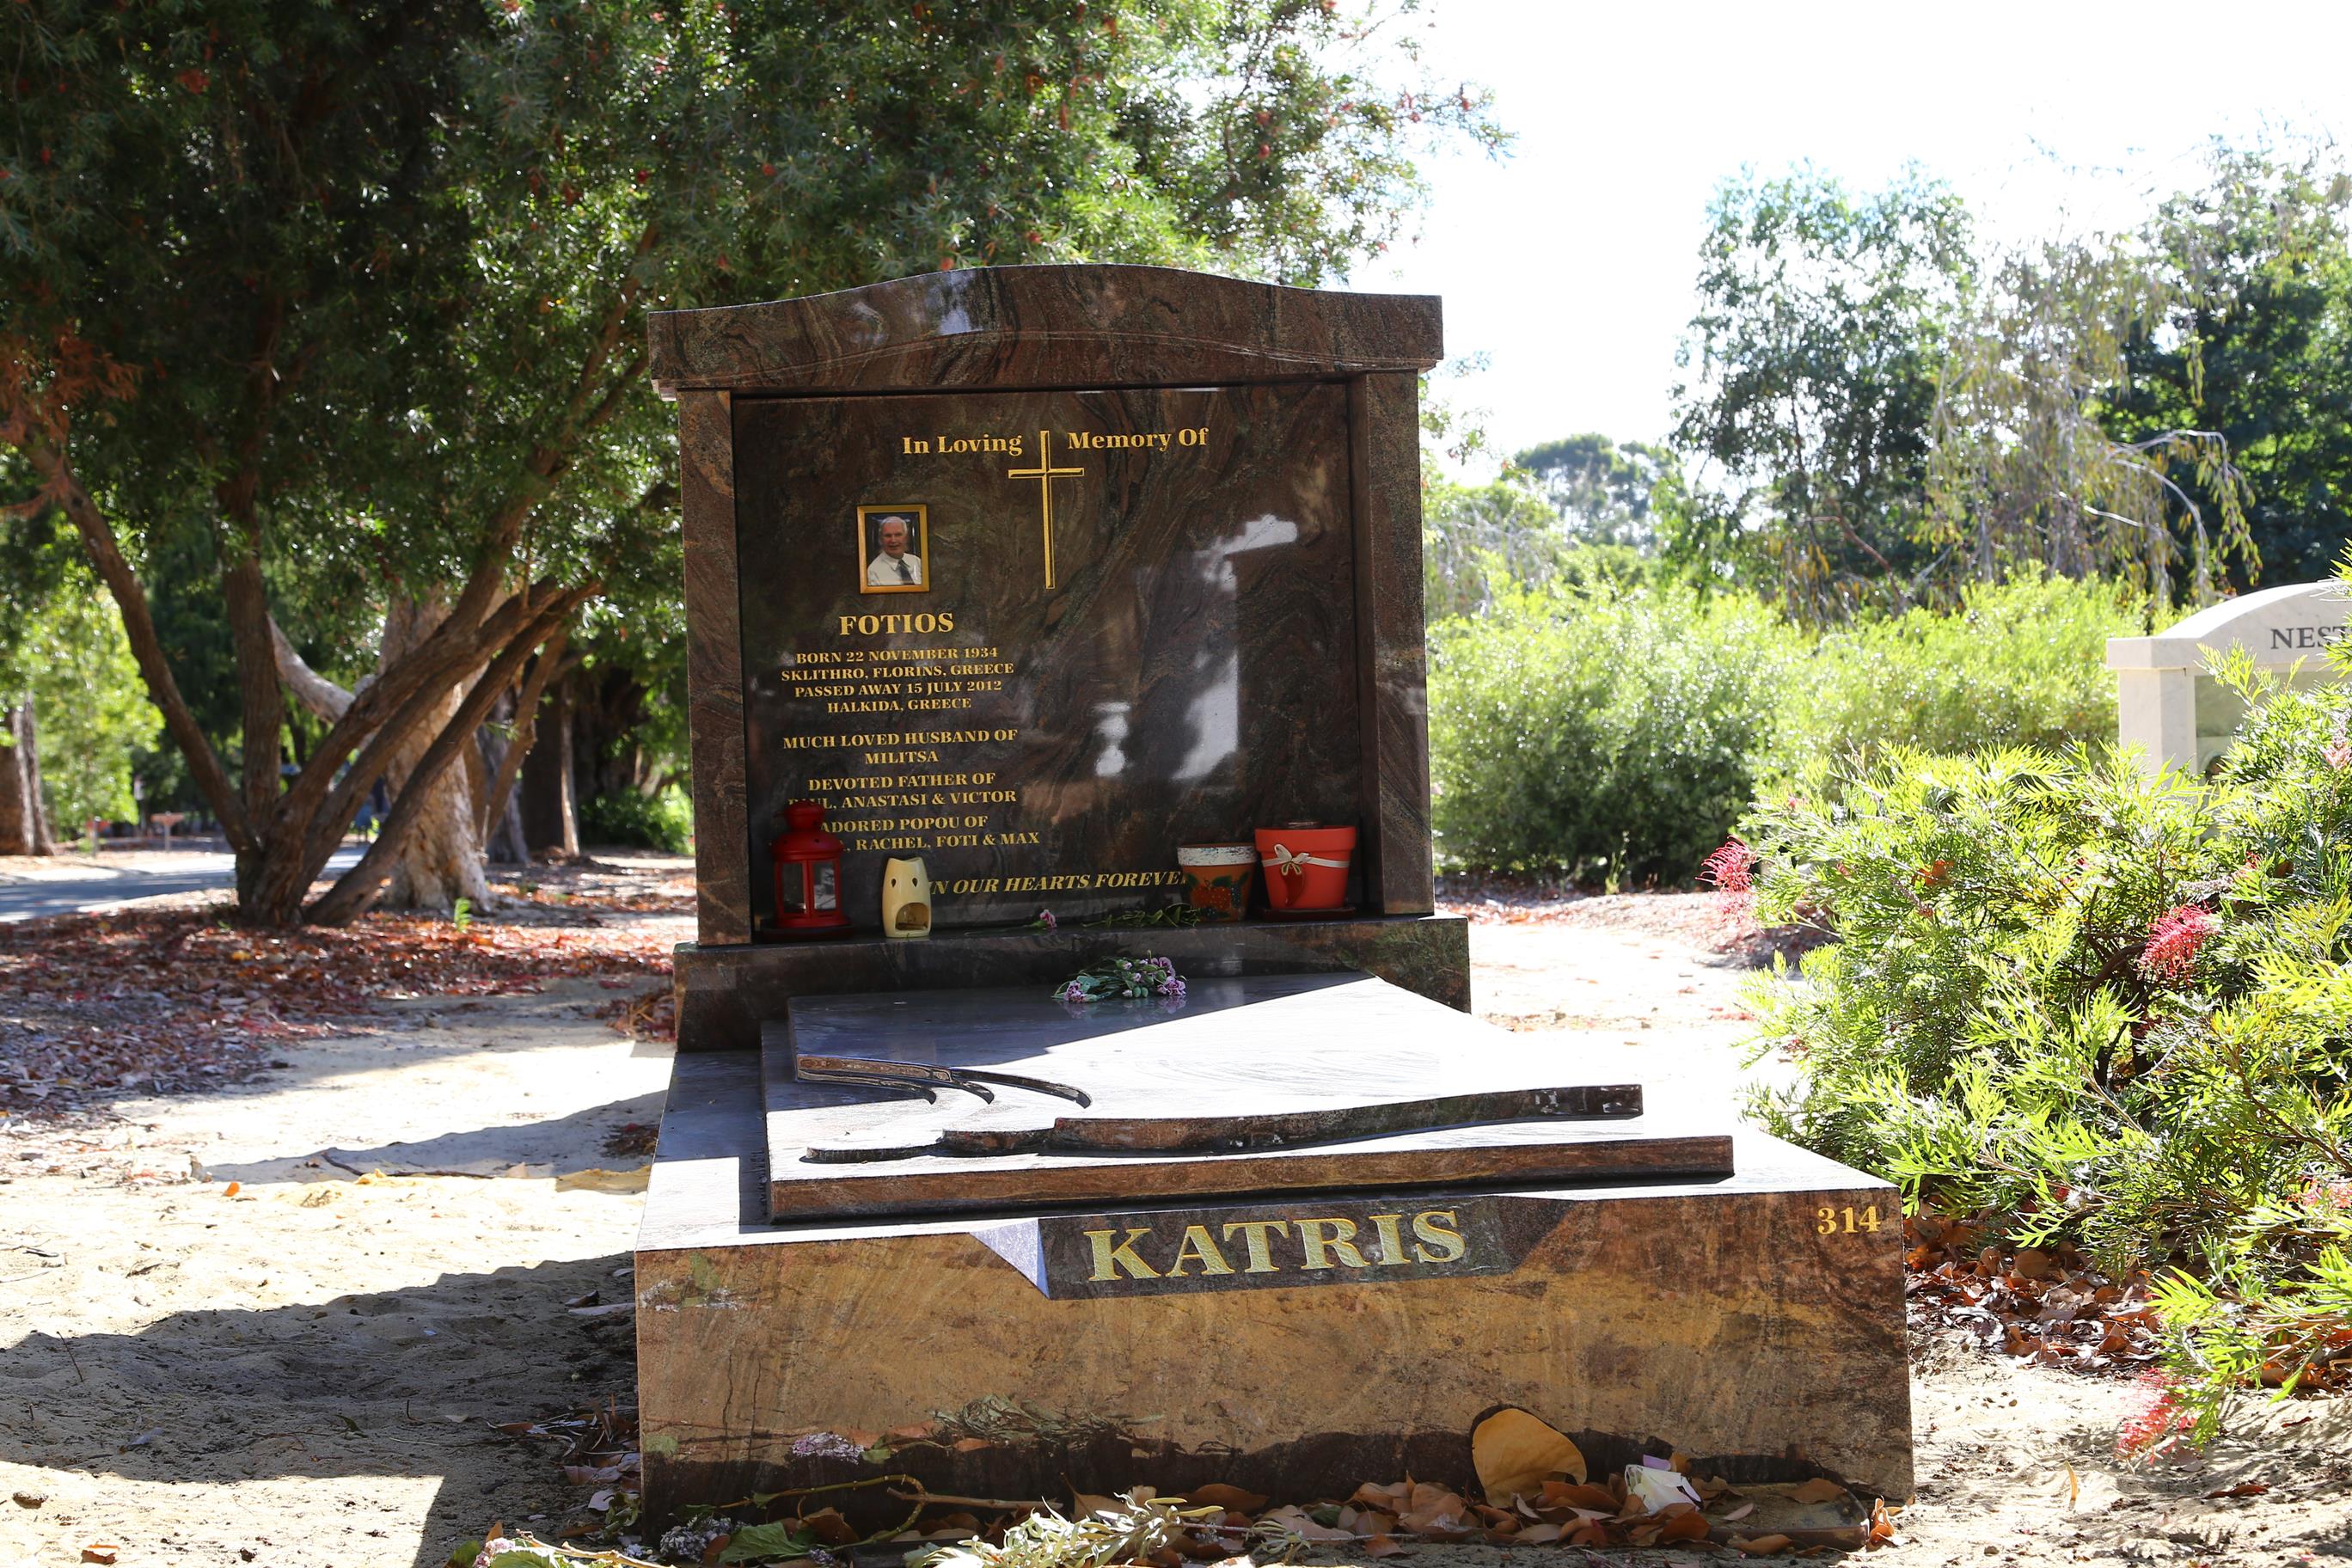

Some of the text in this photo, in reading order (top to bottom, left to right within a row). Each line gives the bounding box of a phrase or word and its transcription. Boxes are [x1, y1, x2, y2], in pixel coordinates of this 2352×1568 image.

[903, 428, 1210, 456] In Loving Memory Of
[839, 612, 954, 635] FOTIOS
[796, 647, 998, 664] BORN 22 NOVEMBER 1934
[781, 663, 1014, 682] SKLITHRO, FLORINS, GREECE
[794, 680, 1002, 698] PASSED AWAY 15 JULY 2012
[827, 698, 971, 714] HALKIDA, GREECE
[783, 729, 1018, 749] MUCH LOVED HUSBAND OF
[865, 750, 939, 764] MILITSA
[808, 772, 995, 791] DEVOTED FATHER OF
[842, 793, 927, 809] ANASTASI
[931, 793, 946, 805] &
[949, 790, 1017, 804] VICTOR
[820, 816, 989, 833] ADORED POPOU OF
[856, 837, 931, 851] RACHEL,
[936, 835, 977, 848] FOTI
[982, 833, 996, 846] &
[1001, 832, 1039, 845] MAX
[952, 879, 1000, 894] OUR
[1004, 873, 1091, 892] HEARTS
[1094, 871, 1186, 888] FOREVE
[1816, 1206, 1881, 1234] 314
[1082, 1210, 1467, 1282] KATRIS
